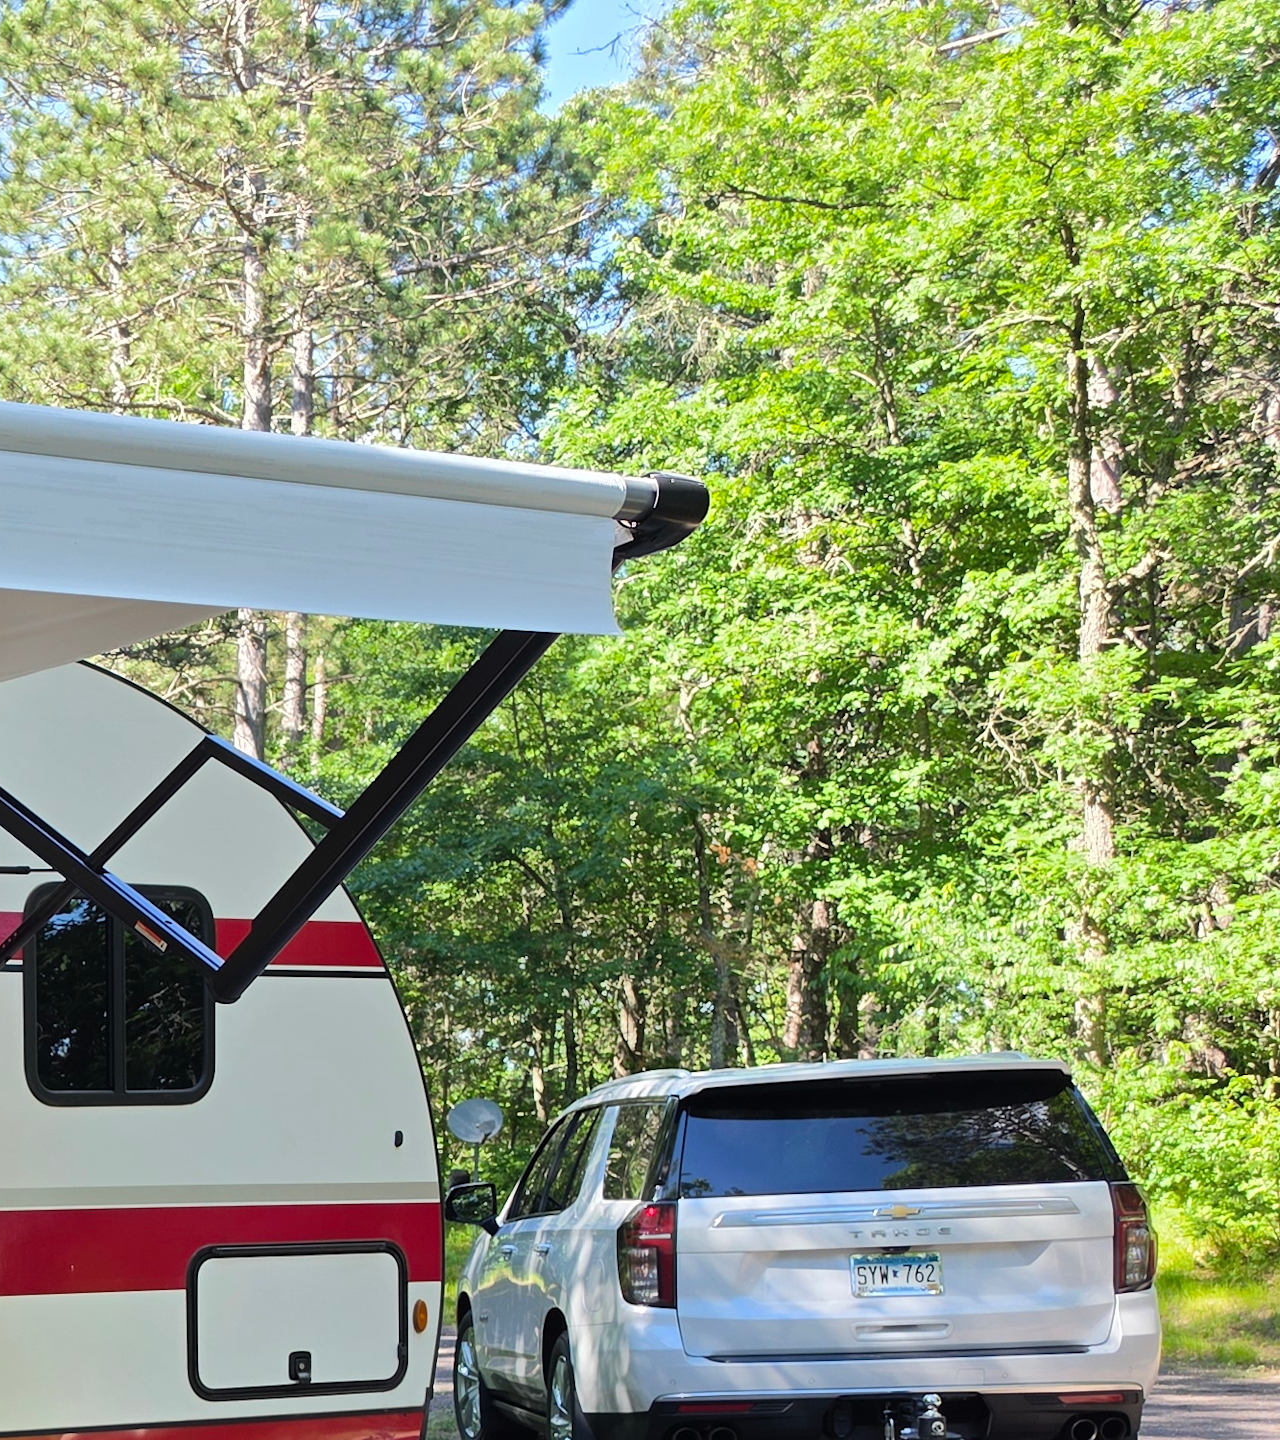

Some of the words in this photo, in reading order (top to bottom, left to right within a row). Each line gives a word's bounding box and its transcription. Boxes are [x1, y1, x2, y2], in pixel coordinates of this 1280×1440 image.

[848, 1227, 952, 1239] TAHOE
[857, 1264, 890, 1286] SYW
[902, 1263, 936, 1284] 762
